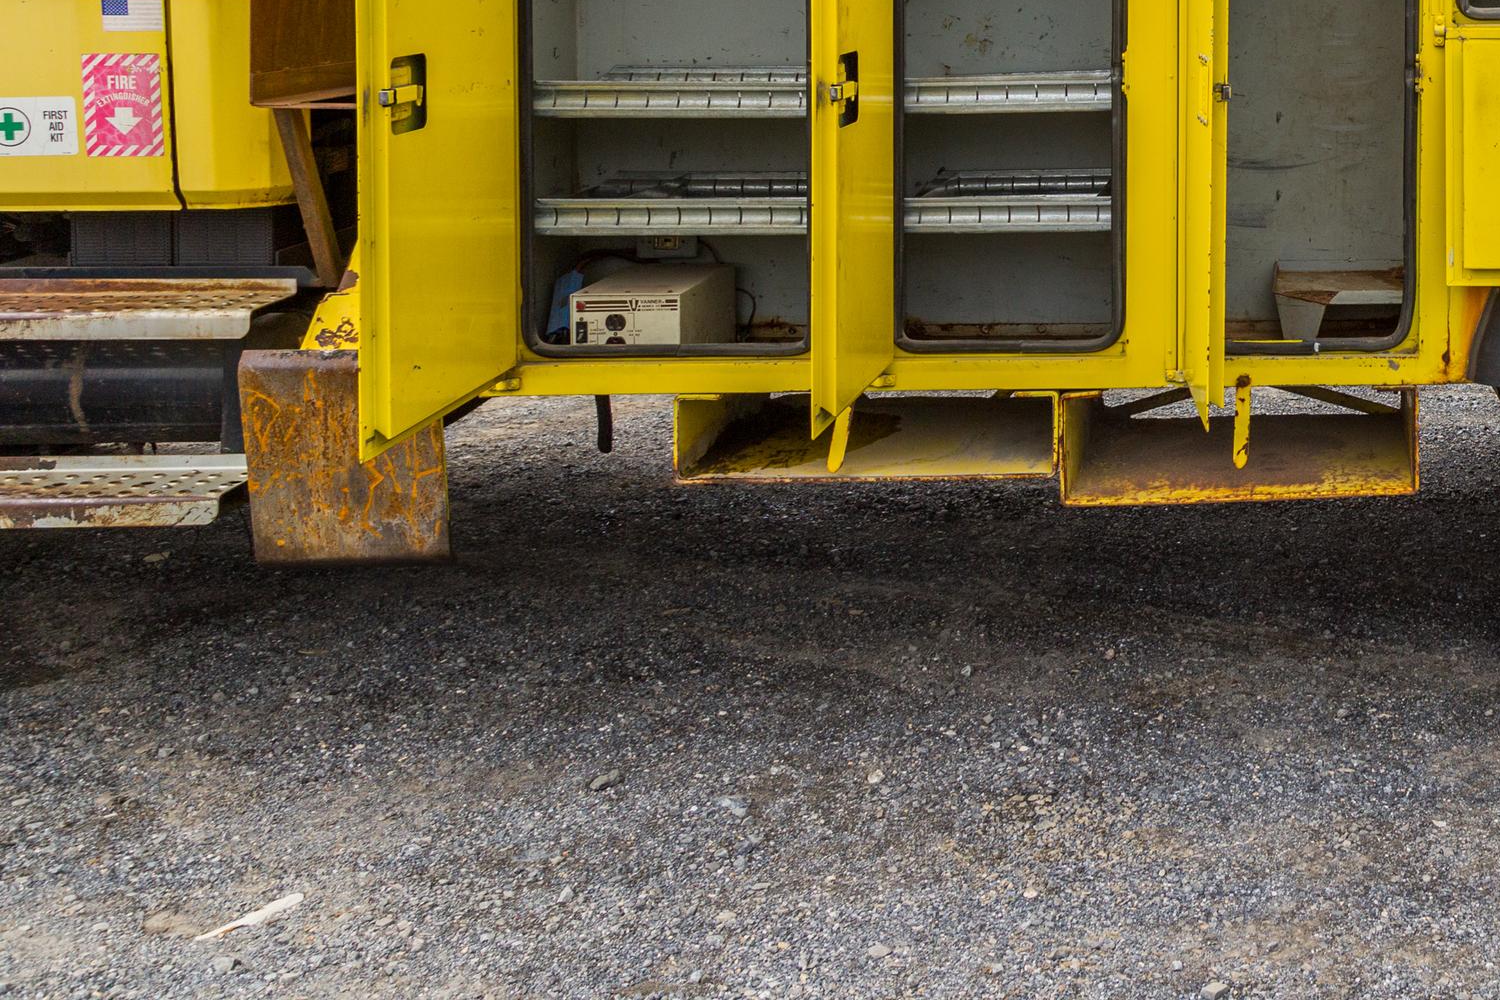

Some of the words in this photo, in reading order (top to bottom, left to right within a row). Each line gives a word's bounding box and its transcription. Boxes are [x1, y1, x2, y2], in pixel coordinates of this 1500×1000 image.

[106, 74, 137, 90] FIRE
[96, 91, 151, 108] EXTINGUISHER
[43, 110, 68, 120] FIRST
[49, 121, 64, 131] AID
[50, 133, 64, 142] KIT
